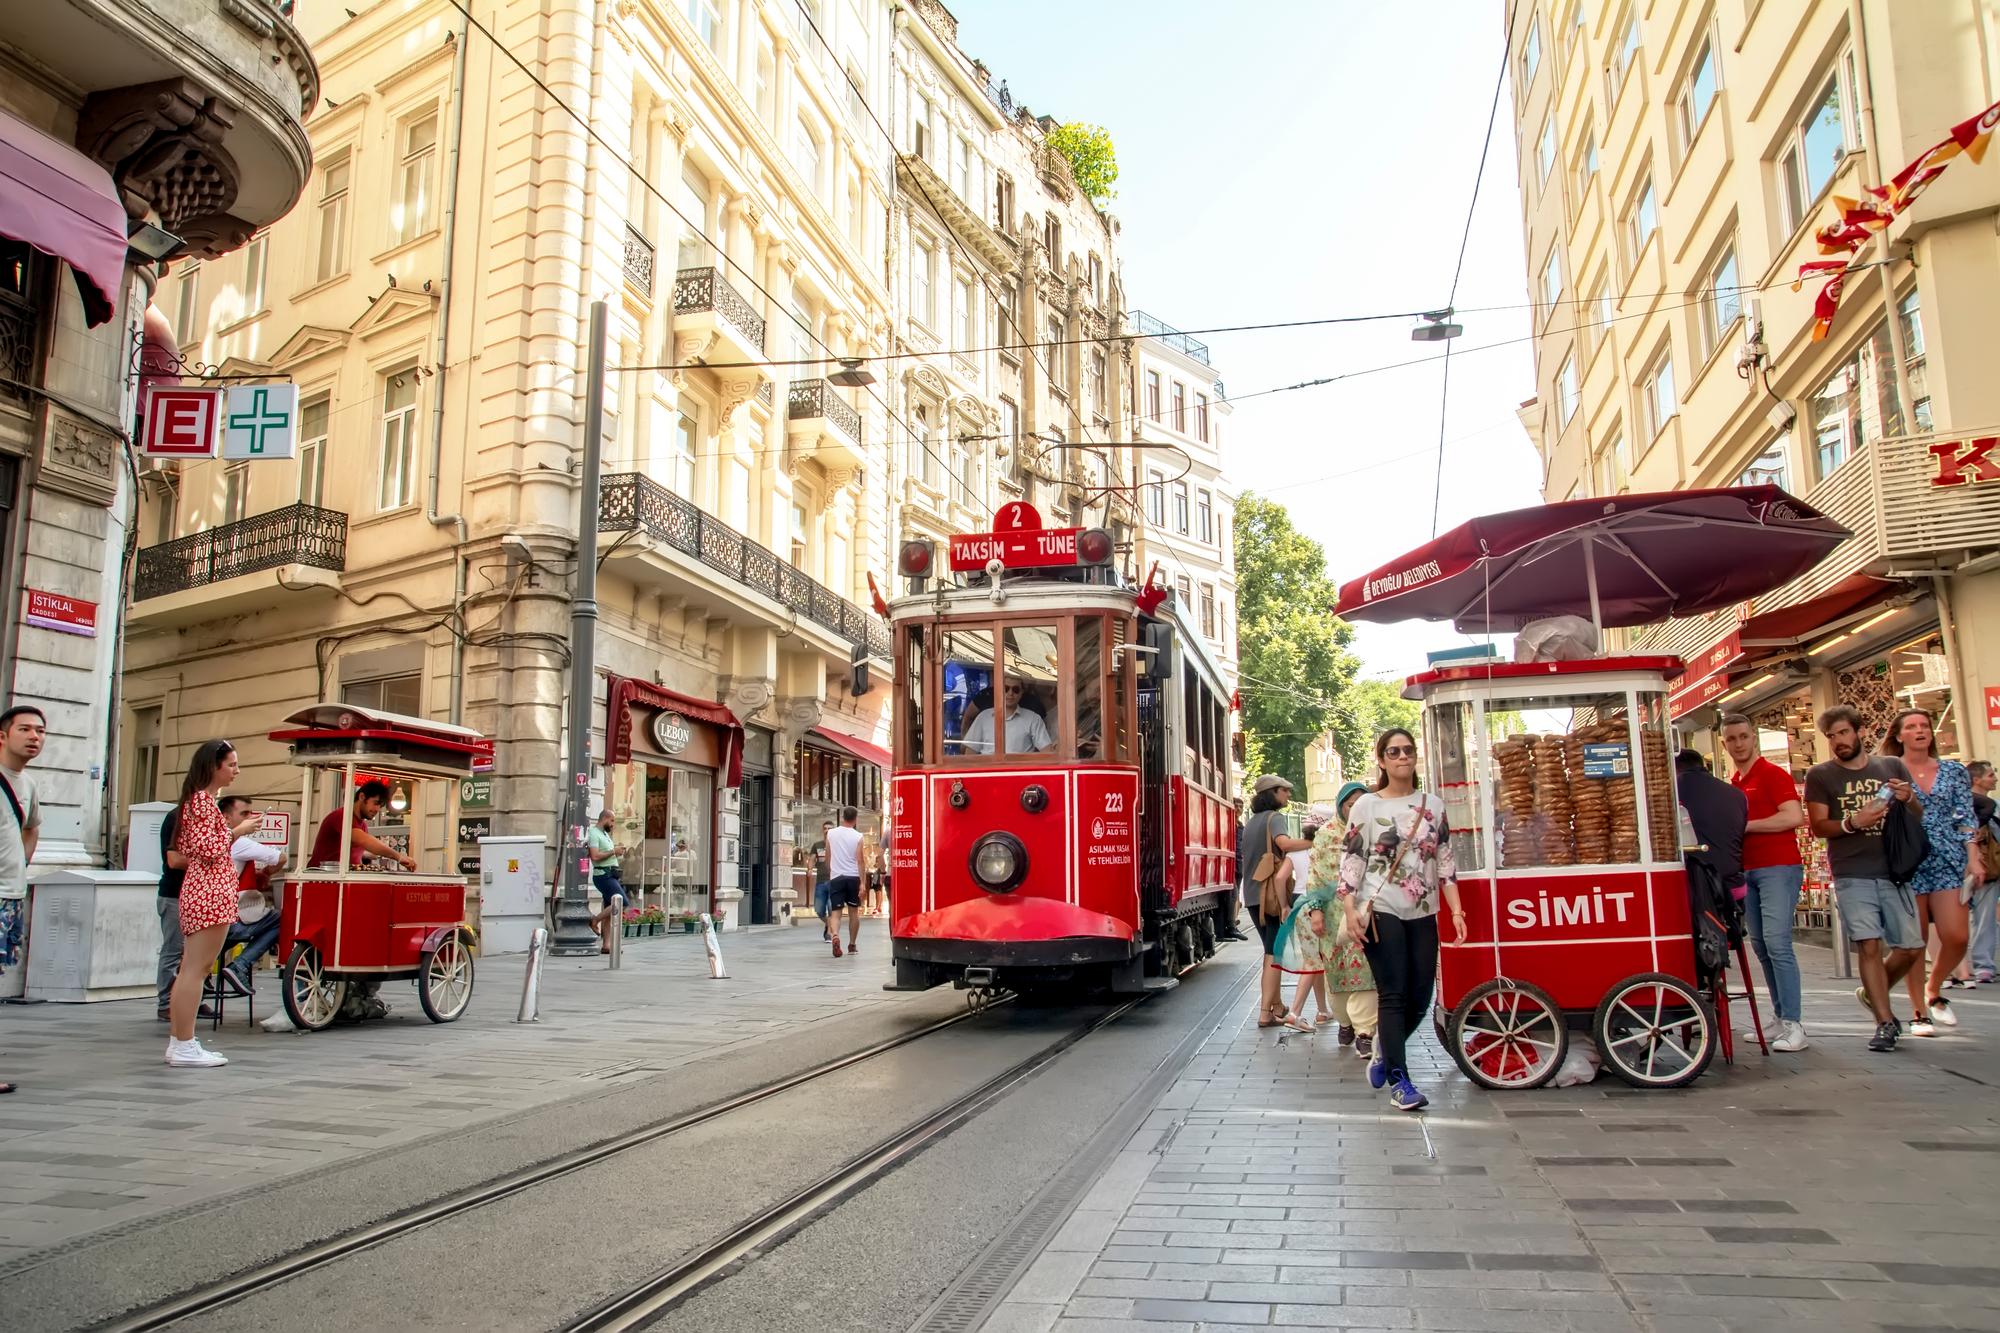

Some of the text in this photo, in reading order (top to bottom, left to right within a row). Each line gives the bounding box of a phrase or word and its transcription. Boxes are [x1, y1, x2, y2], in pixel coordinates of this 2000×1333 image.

[162, 399, 201, 445] E
[1011, 505, 1022, 528] 2
[954, 536, 1005, 561] TAKSİM
[1037, 532, 1076, 555] TÜNE
[1371, 560, 1442, 597] BEYOĞLU BELEDİYESİ
[33, 593, 75, 613] İSTİKLAL
[660, 723, 690, 742] LEBON
[1845, 778, 1882, 795] LAST
[1105, 792, 1123, 813] 223
[1087, 857, 1096, 865] VE
[1507, 886, 1635, 929] SİMİT
